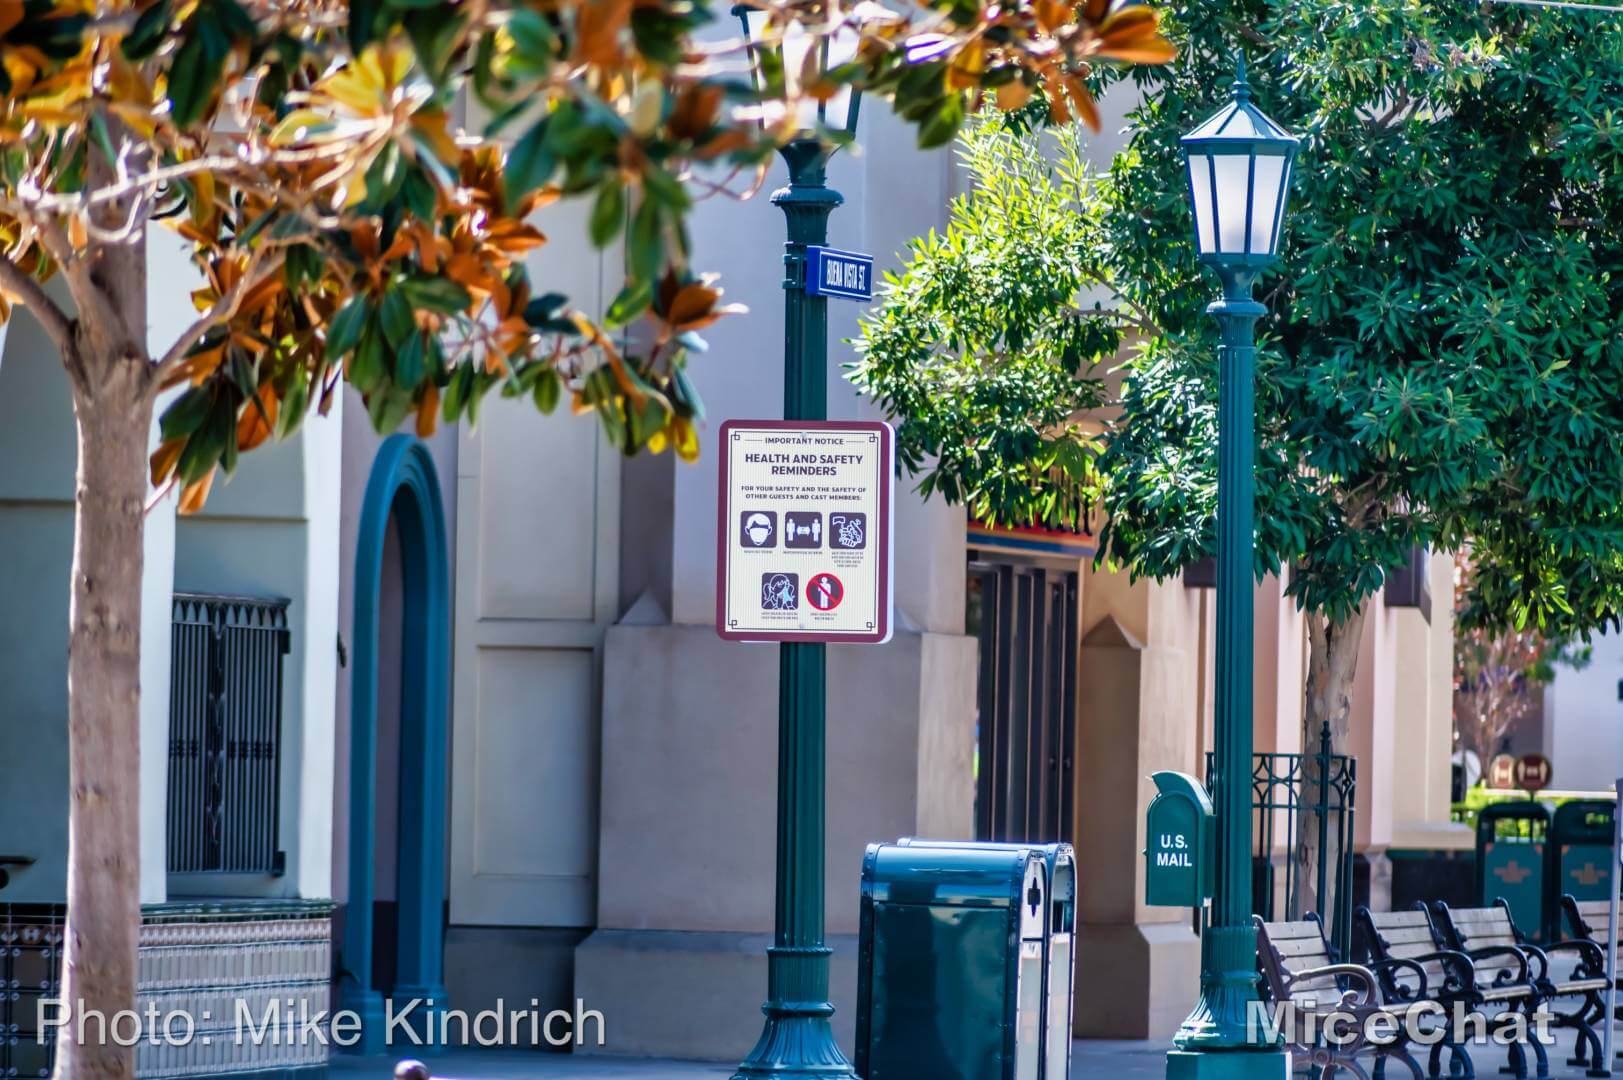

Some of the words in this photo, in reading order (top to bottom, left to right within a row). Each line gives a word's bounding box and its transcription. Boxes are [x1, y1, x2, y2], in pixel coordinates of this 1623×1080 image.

[826, 259, 843, 287] BUENA
[844, 262, 858, 289] VISTA
[765, 437, 813, 445] IMPORTANT
[745, 453, 790, 463] HEALTH
[793, 454, 817, 463] AND
[819, 454, 864, 464] SAFETY
[771, 465, 837, 475] REMINDERS
[1160, 834, 1188, 849] U.S.
[1156, 852, 1193, 867] MAIL
